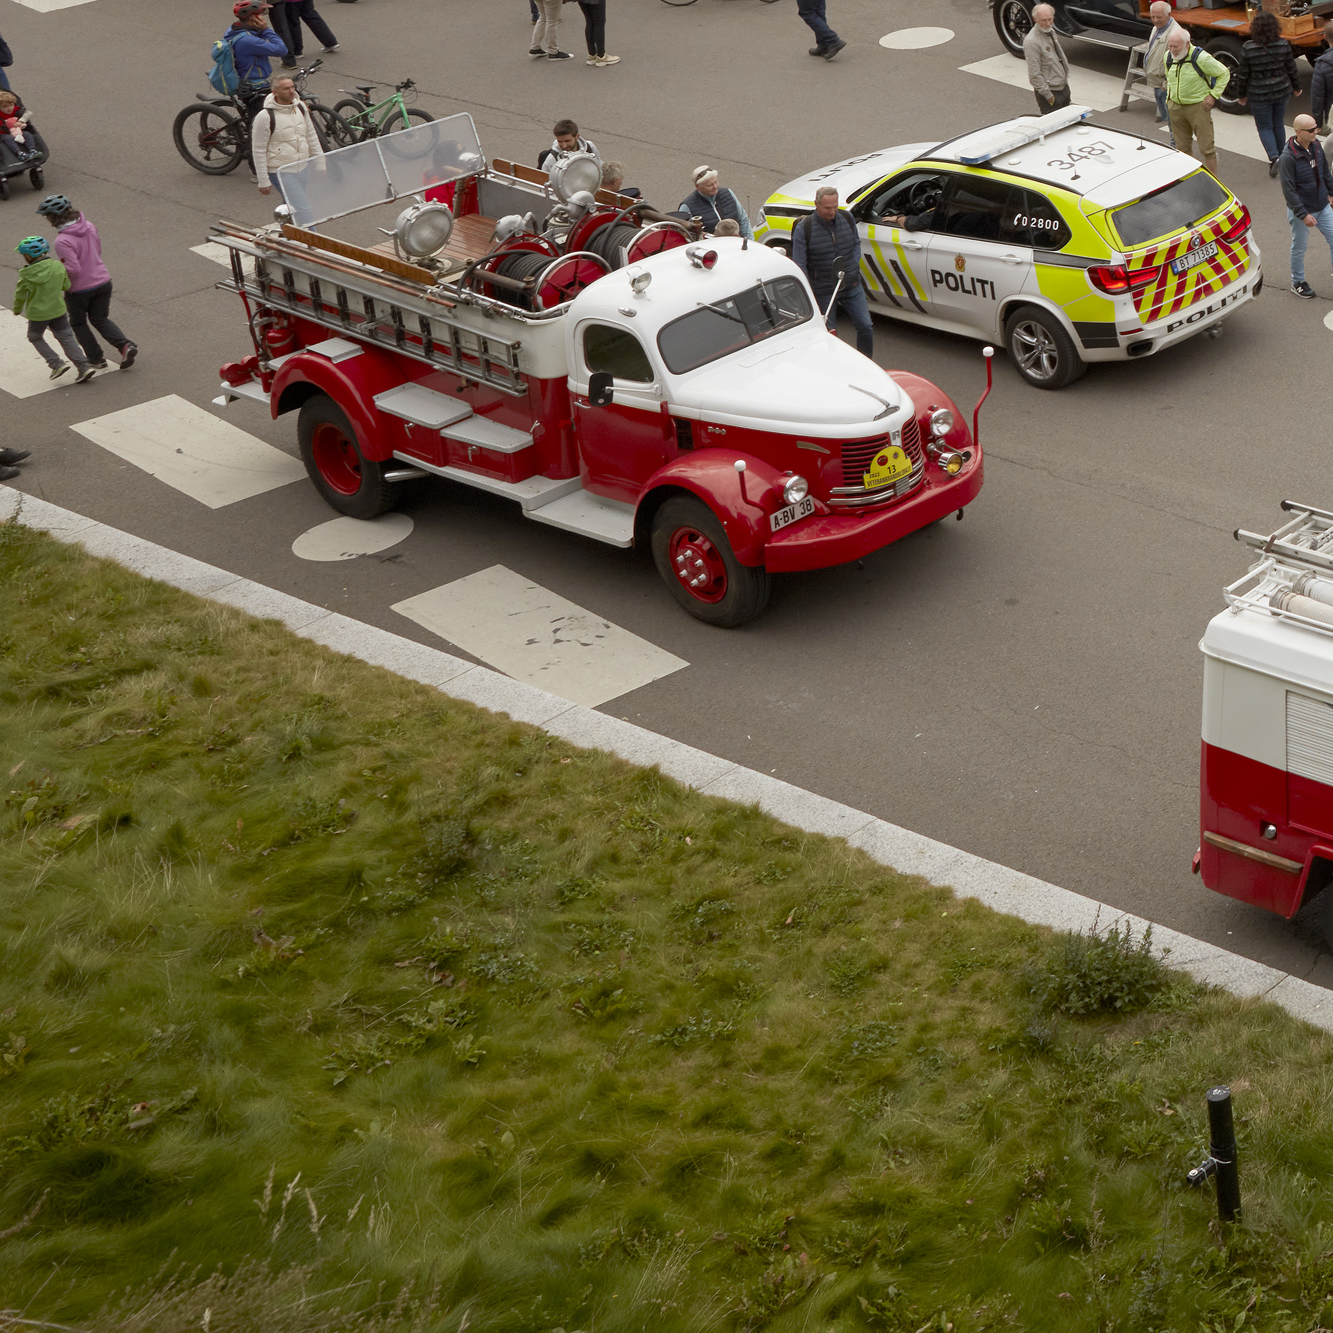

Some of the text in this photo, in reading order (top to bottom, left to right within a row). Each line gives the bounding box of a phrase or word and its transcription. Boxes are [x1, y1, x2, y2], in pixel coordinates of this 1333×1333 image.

[808, 152, 884, 182] POLITI
[1046, 140, 1116, 172] 3487
[1178, 245, 1216, 269] BT 71385
[931, 268, 997, 301] POLITI
[1166, 285, 1248, 333] POLITI
[886, 464, 897, 475] 13
[773, 497, 813, 529] A-BV 38
